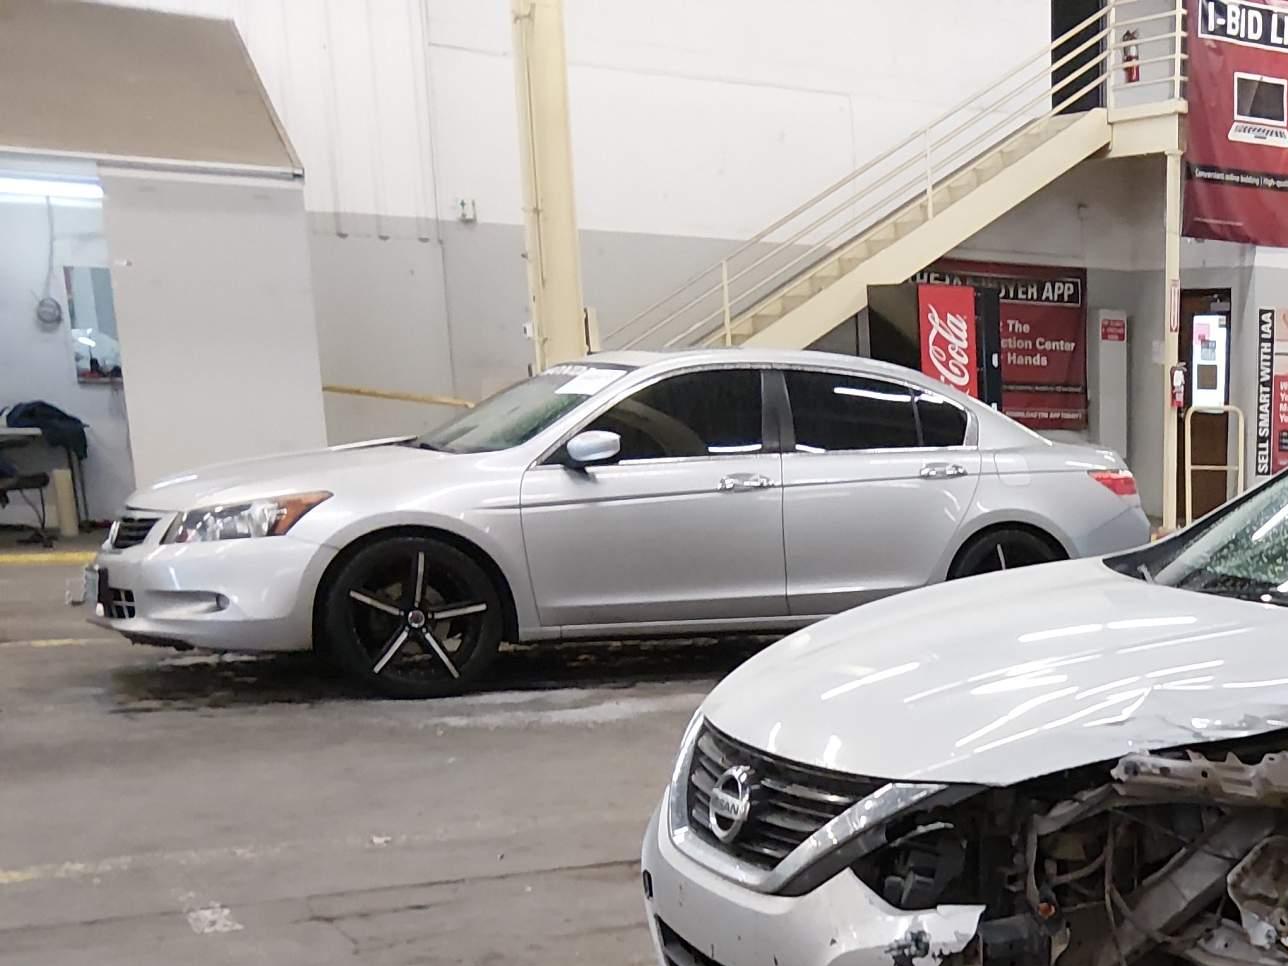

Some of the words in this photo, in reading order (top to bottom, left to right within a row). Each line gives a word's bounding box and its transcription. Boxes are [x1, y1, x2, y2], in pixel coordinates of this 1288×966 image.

[1207, 2, 1263, 40] I-BID
[1041, 282, 1075, 302] APP
[1007, 320, 1031, 334] The
[1261, 311, 1273, 339] IAA
[928, 304, 969, 386] Cola
[1001, 335, 1033, 350] ction
[1035, 337, 1076, 352] Center
[1007, 352, 1048, 367] Hands
[1260, 342, 1271, 382] WITH
[1258, 385, 1271, 437] SMART
[1257, 439, 1269, 475] SELL
